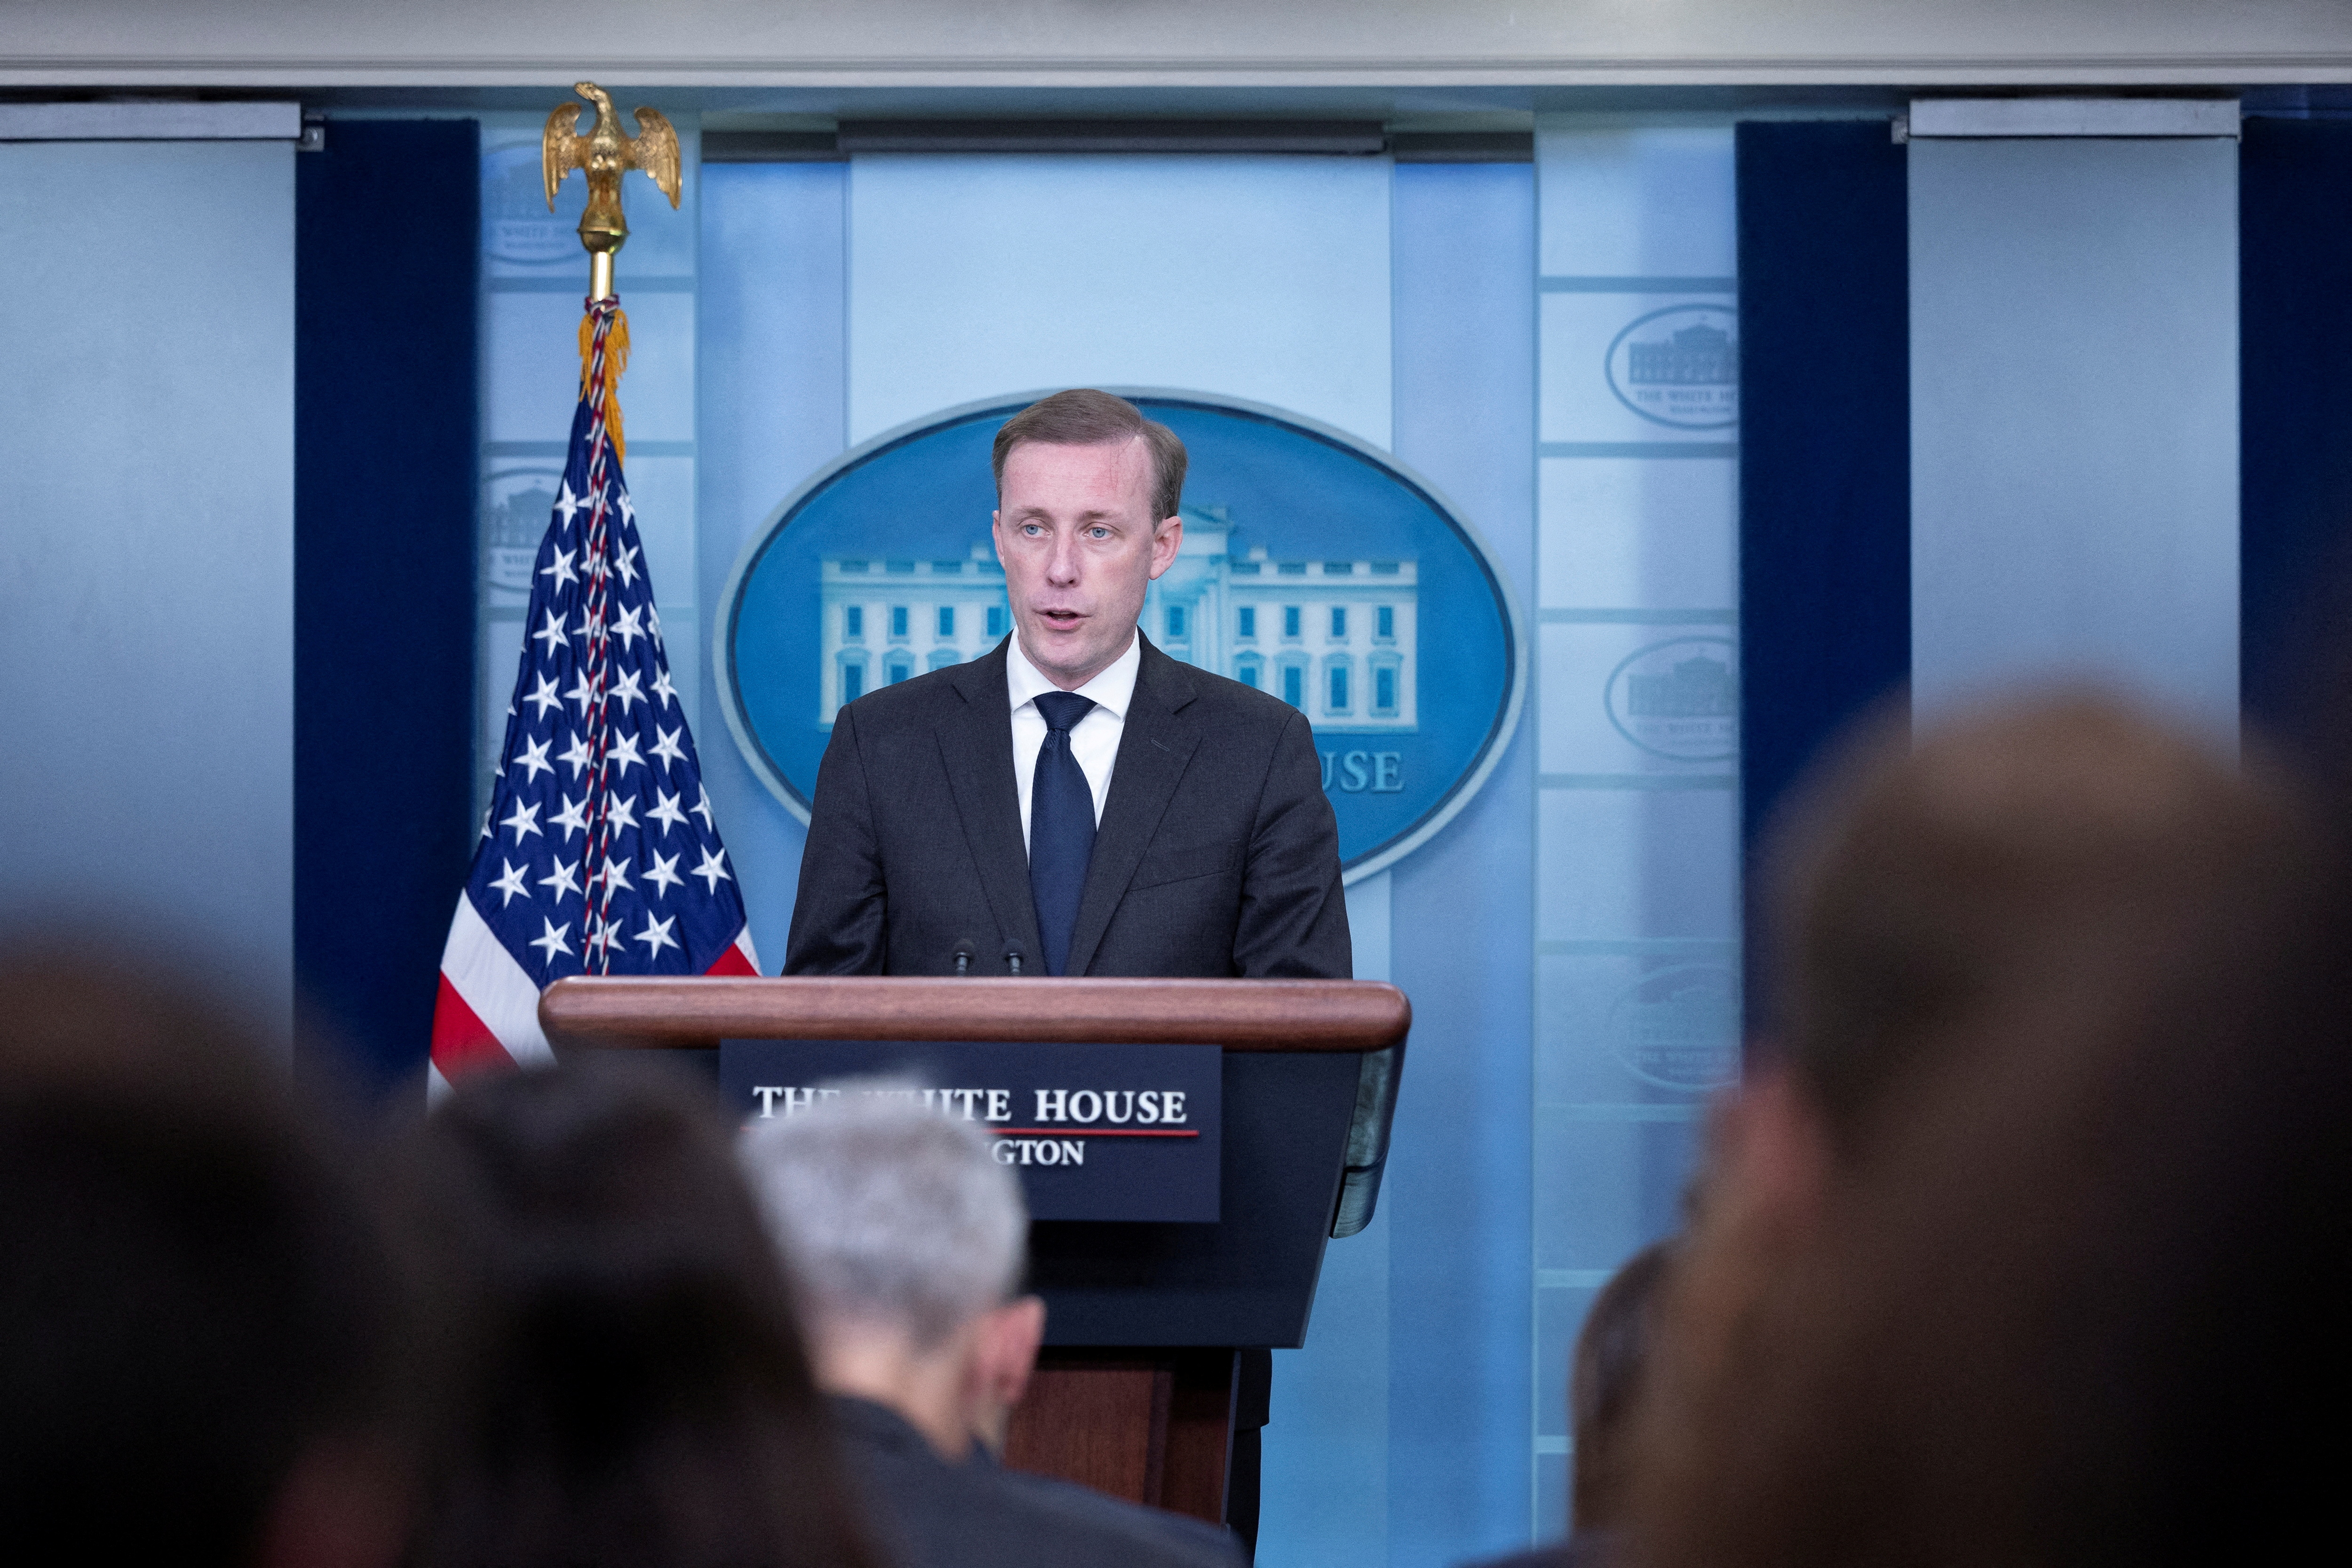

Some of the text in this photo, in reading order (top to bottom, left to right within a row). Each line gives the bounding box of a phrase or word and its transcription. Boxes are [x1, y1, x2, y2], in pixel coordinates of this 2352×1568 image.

[753, 1086, 841, 1118] TH
[1034, 1089, 1188, 1123] HOUSE
[986, 1139, 1086, 1166] GTON
